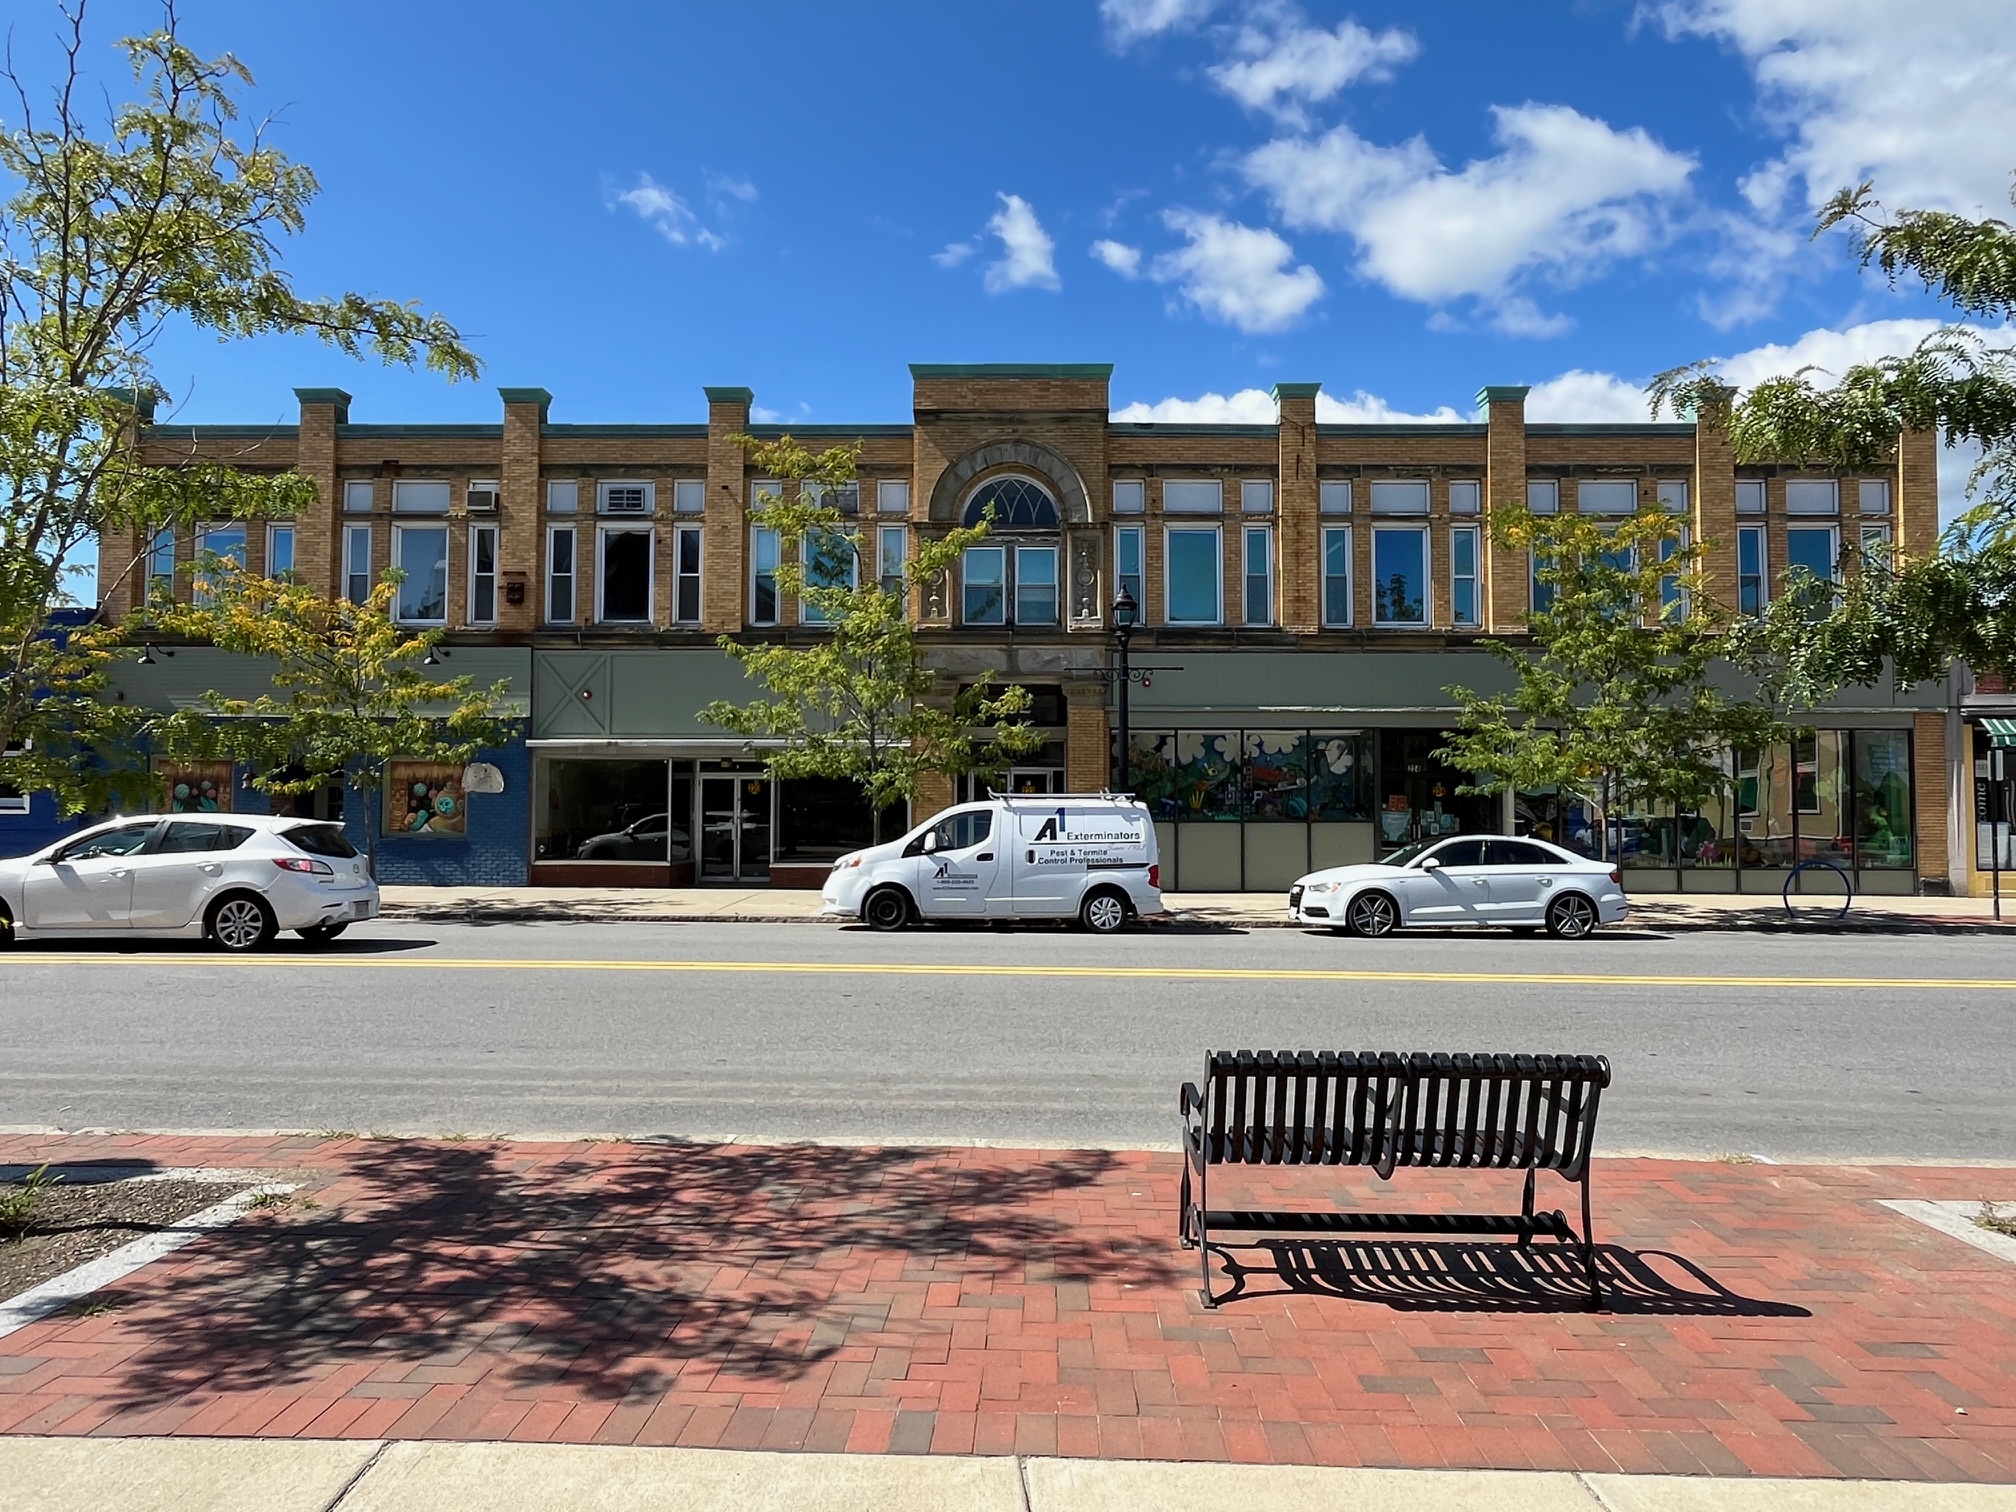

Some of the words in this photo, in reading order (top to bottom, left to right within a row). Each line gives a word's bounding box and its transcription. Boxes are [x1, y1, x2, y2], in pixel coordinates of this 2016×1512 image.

[1034, 807, 1066, 841] A1
[1067, 832, 1140, 841] Exterminators
[1050, 849, 1068, 857] Pest
[1037, 857, 1067, 865] Control
[1069, 856, 1124, 864] Professionals
[932, 862, 948, 879] A1
